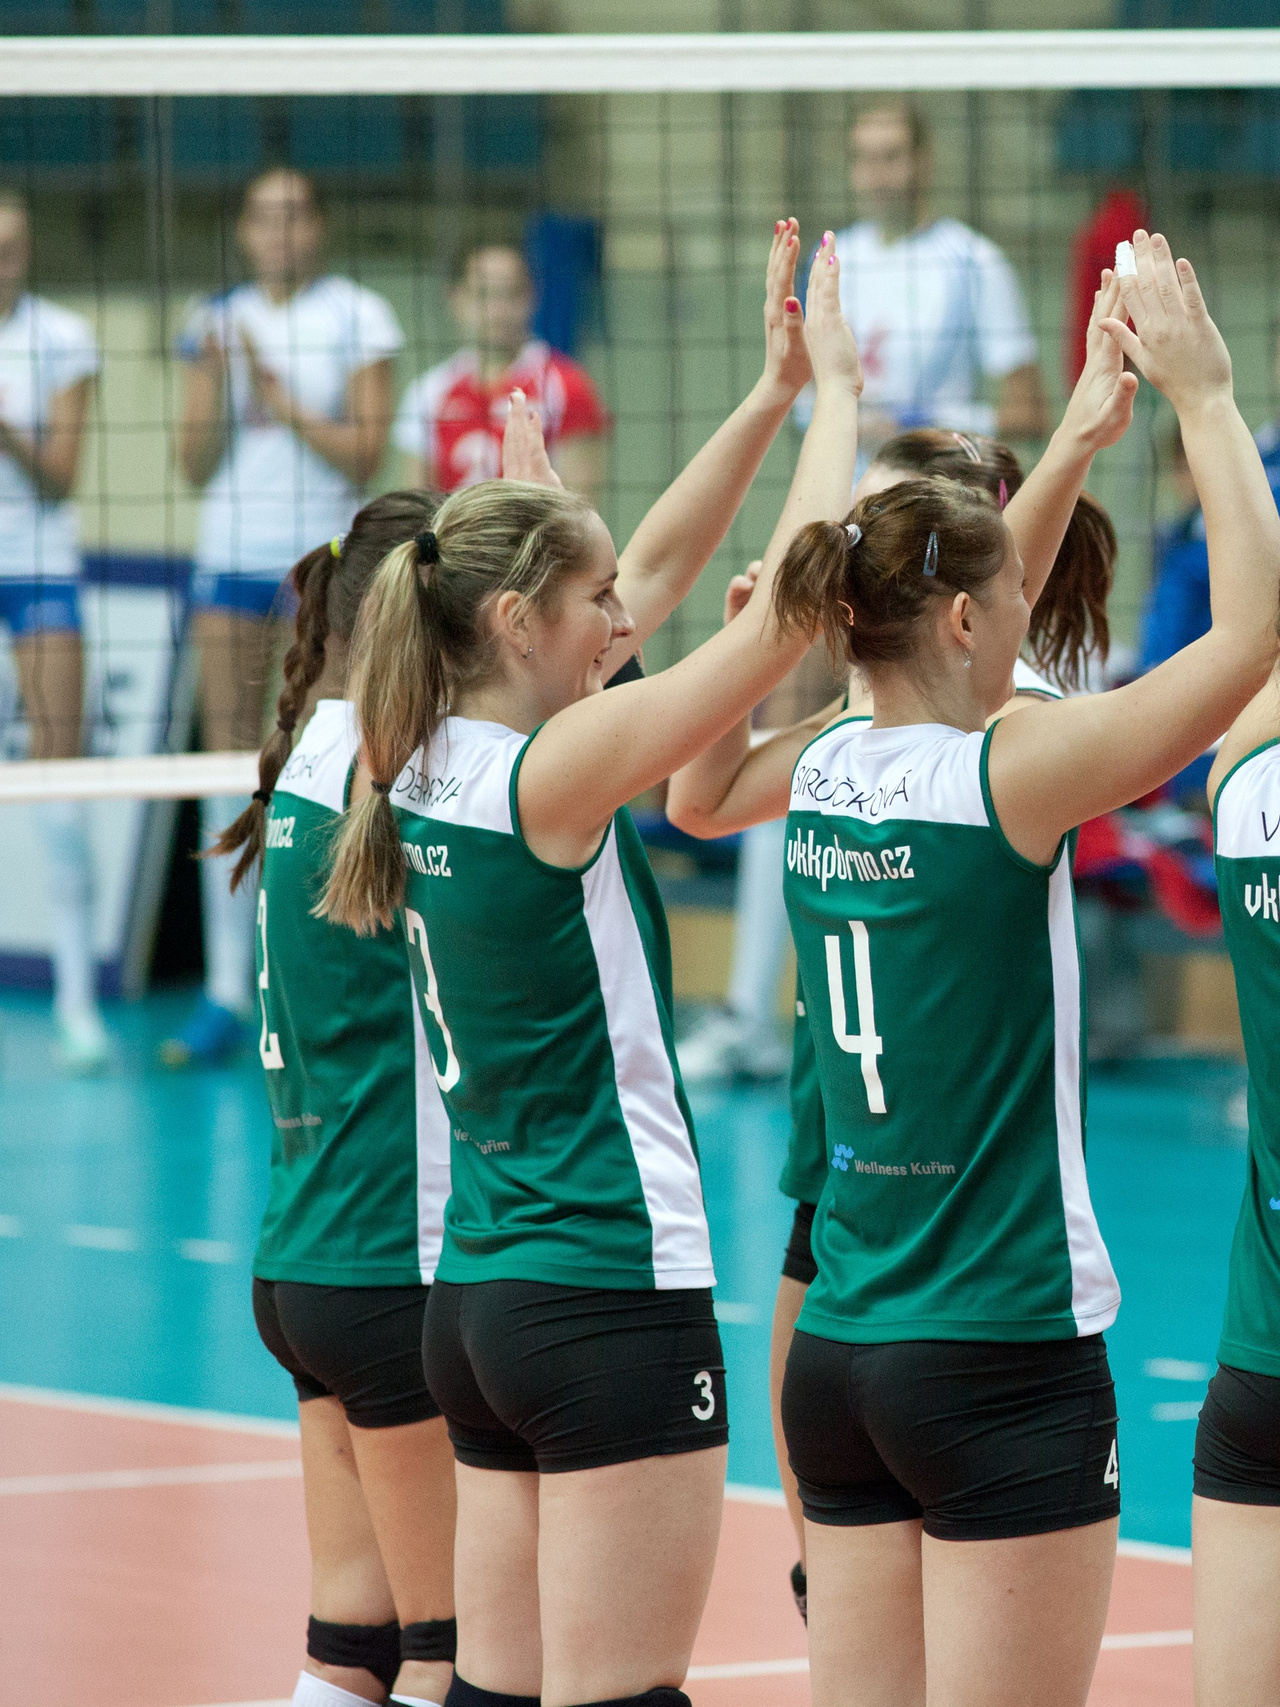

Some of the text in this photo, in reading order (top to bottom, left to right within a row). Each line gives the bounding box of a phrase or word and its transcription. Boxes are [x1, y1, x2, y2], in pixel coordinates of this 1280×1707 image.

[787, 827, 915, 892] vkkpbrno.cz
[404, 906, 461, 1093] 3
[824, 920, 888, 1114] 4
[854, 1159, 956, 1176] Wellness Kuřim
[691, 1370, 715, 1421] 3
[1103, 1438, 1119, 1490] 4
